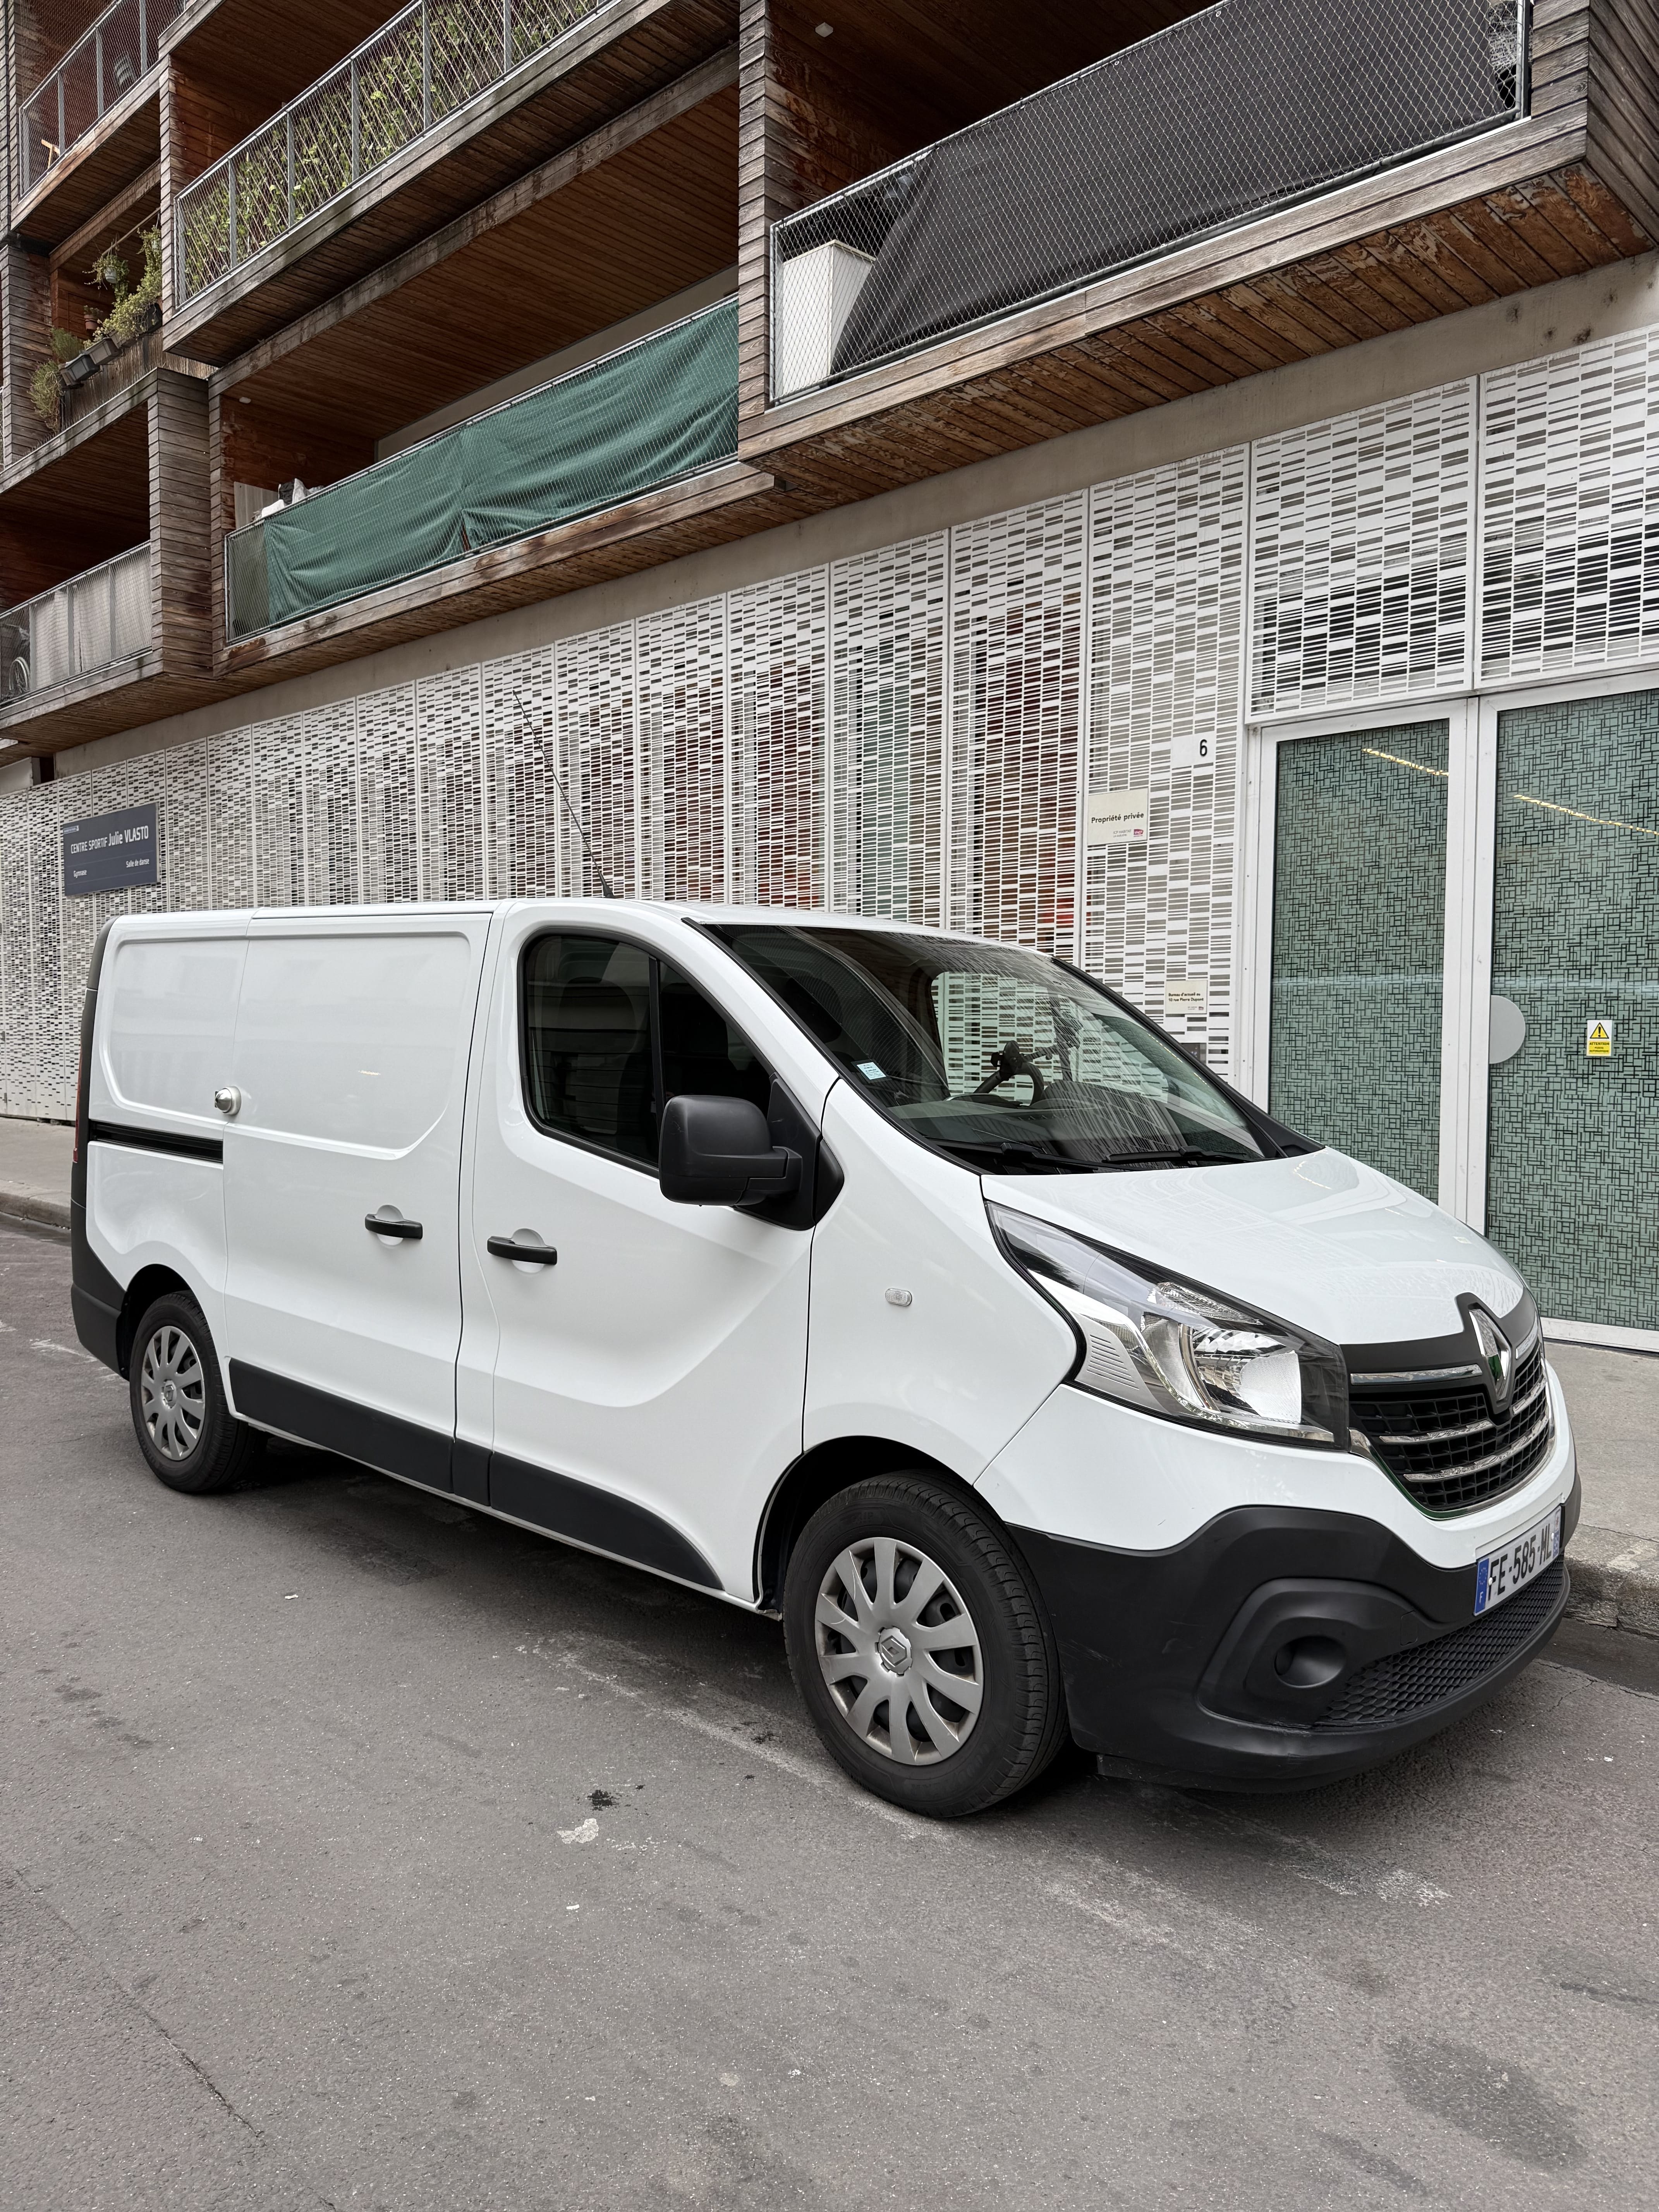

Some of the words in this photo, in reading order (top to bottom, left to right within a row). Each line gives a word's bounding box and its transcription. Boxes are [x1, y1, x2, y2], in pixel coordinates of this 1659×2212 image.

[1200, 739, 1207, 757] 6
[1091, 814, 1121, 824] Propriété
[1124, 812, 1144, 821] privée
[71, 841, 88, 854] CENTRE
[89, 837, 108, 850] SPORTIF
[108, 831, 123, 846] Julie
[124, 825, 149, 843] VLASTO
[74, 870, 87, 878] Gymnase
[1479, 1591, 1484, 1604] F
[1488, 1523, 1551, 1601] FE-585-ML
